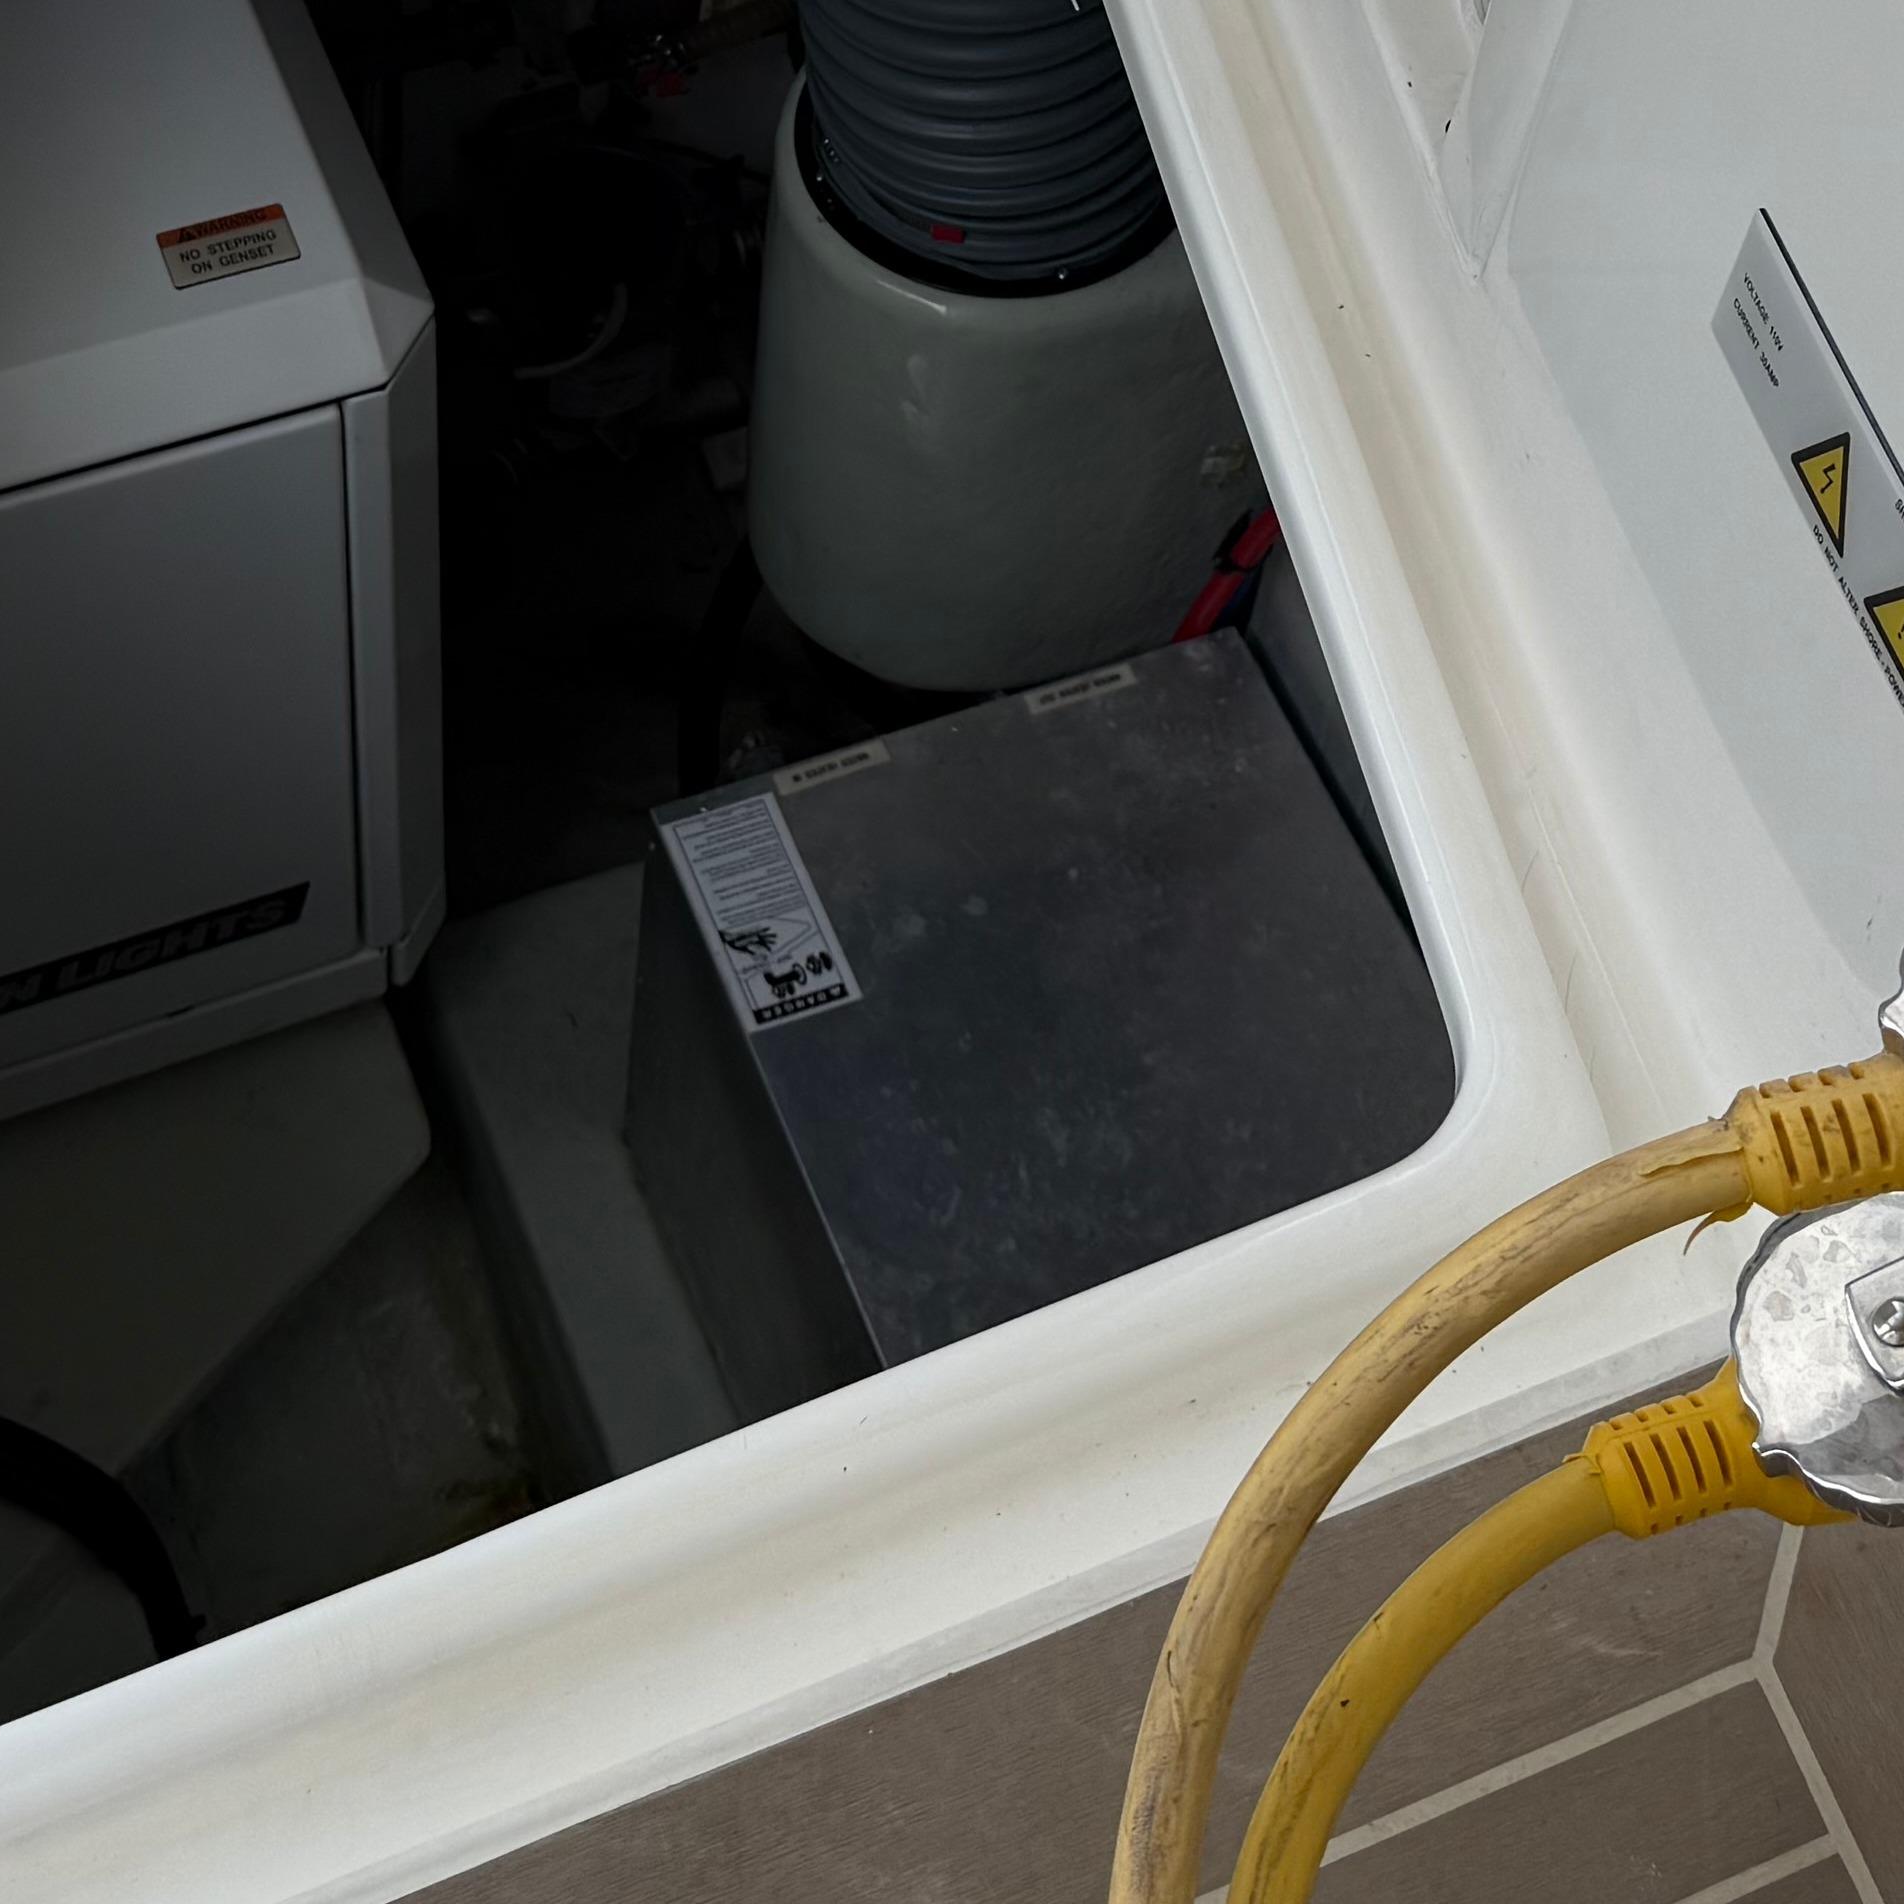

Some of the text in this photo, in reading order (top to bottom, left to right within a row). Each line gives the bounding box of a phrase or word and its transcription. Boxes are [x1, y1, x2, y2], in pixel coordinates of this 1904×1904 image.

[179, 229, 277, 263] NO STEPPING
[191, 244, 275, 274] ON GENSET
[1813, 525, 1824, 545] DO
[1824, 546, 1839, 573] NOT
[1838, 576, 1859, 617] ALTER
[55, 897, 289, 993] LIGHTS
